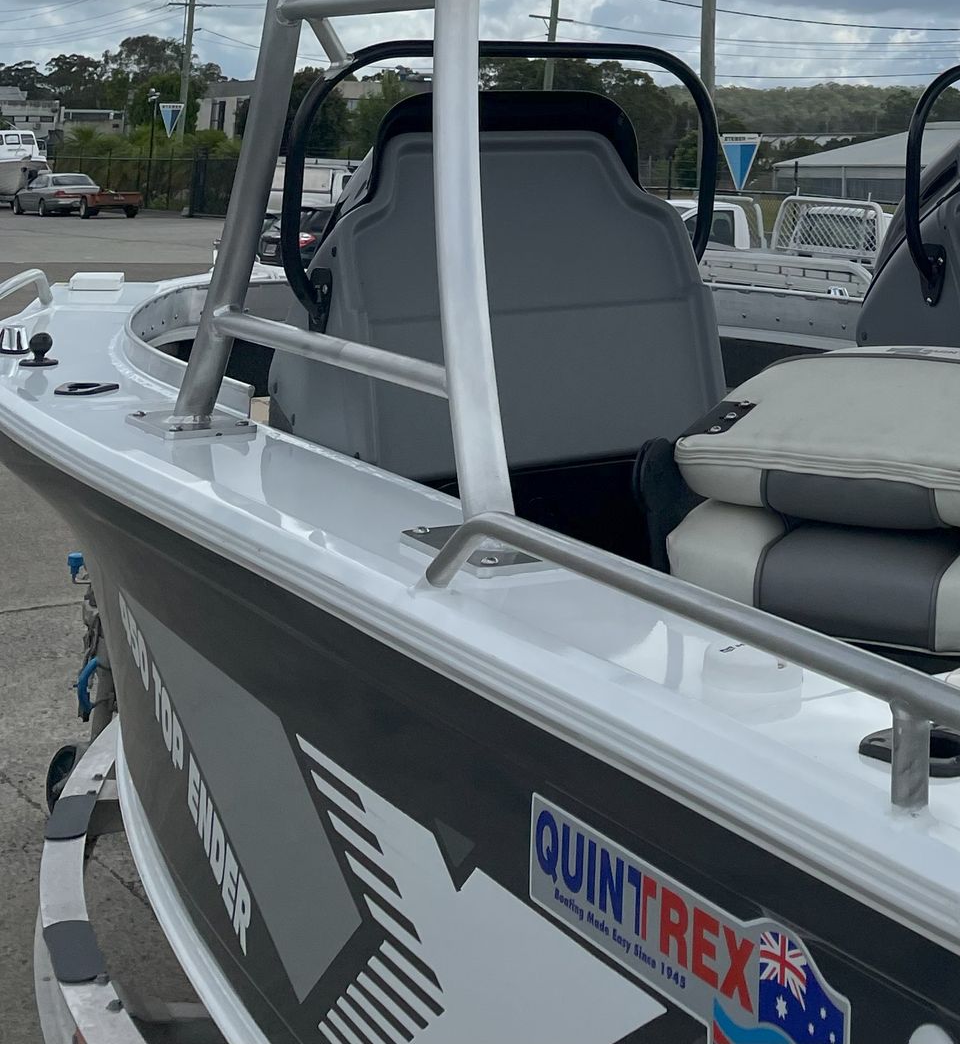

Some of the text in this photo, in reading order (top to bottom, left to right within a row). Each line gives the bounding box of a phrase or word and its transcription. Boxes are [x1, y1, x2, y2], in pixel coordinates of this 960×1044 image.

[118, 591, 149, 691] 450
[187, 752, 251, 956] ENDER
[535, 810, 757, 1014] QUINTREX
[554, 888, 686, 989] Boating Made Easy Since 1945
